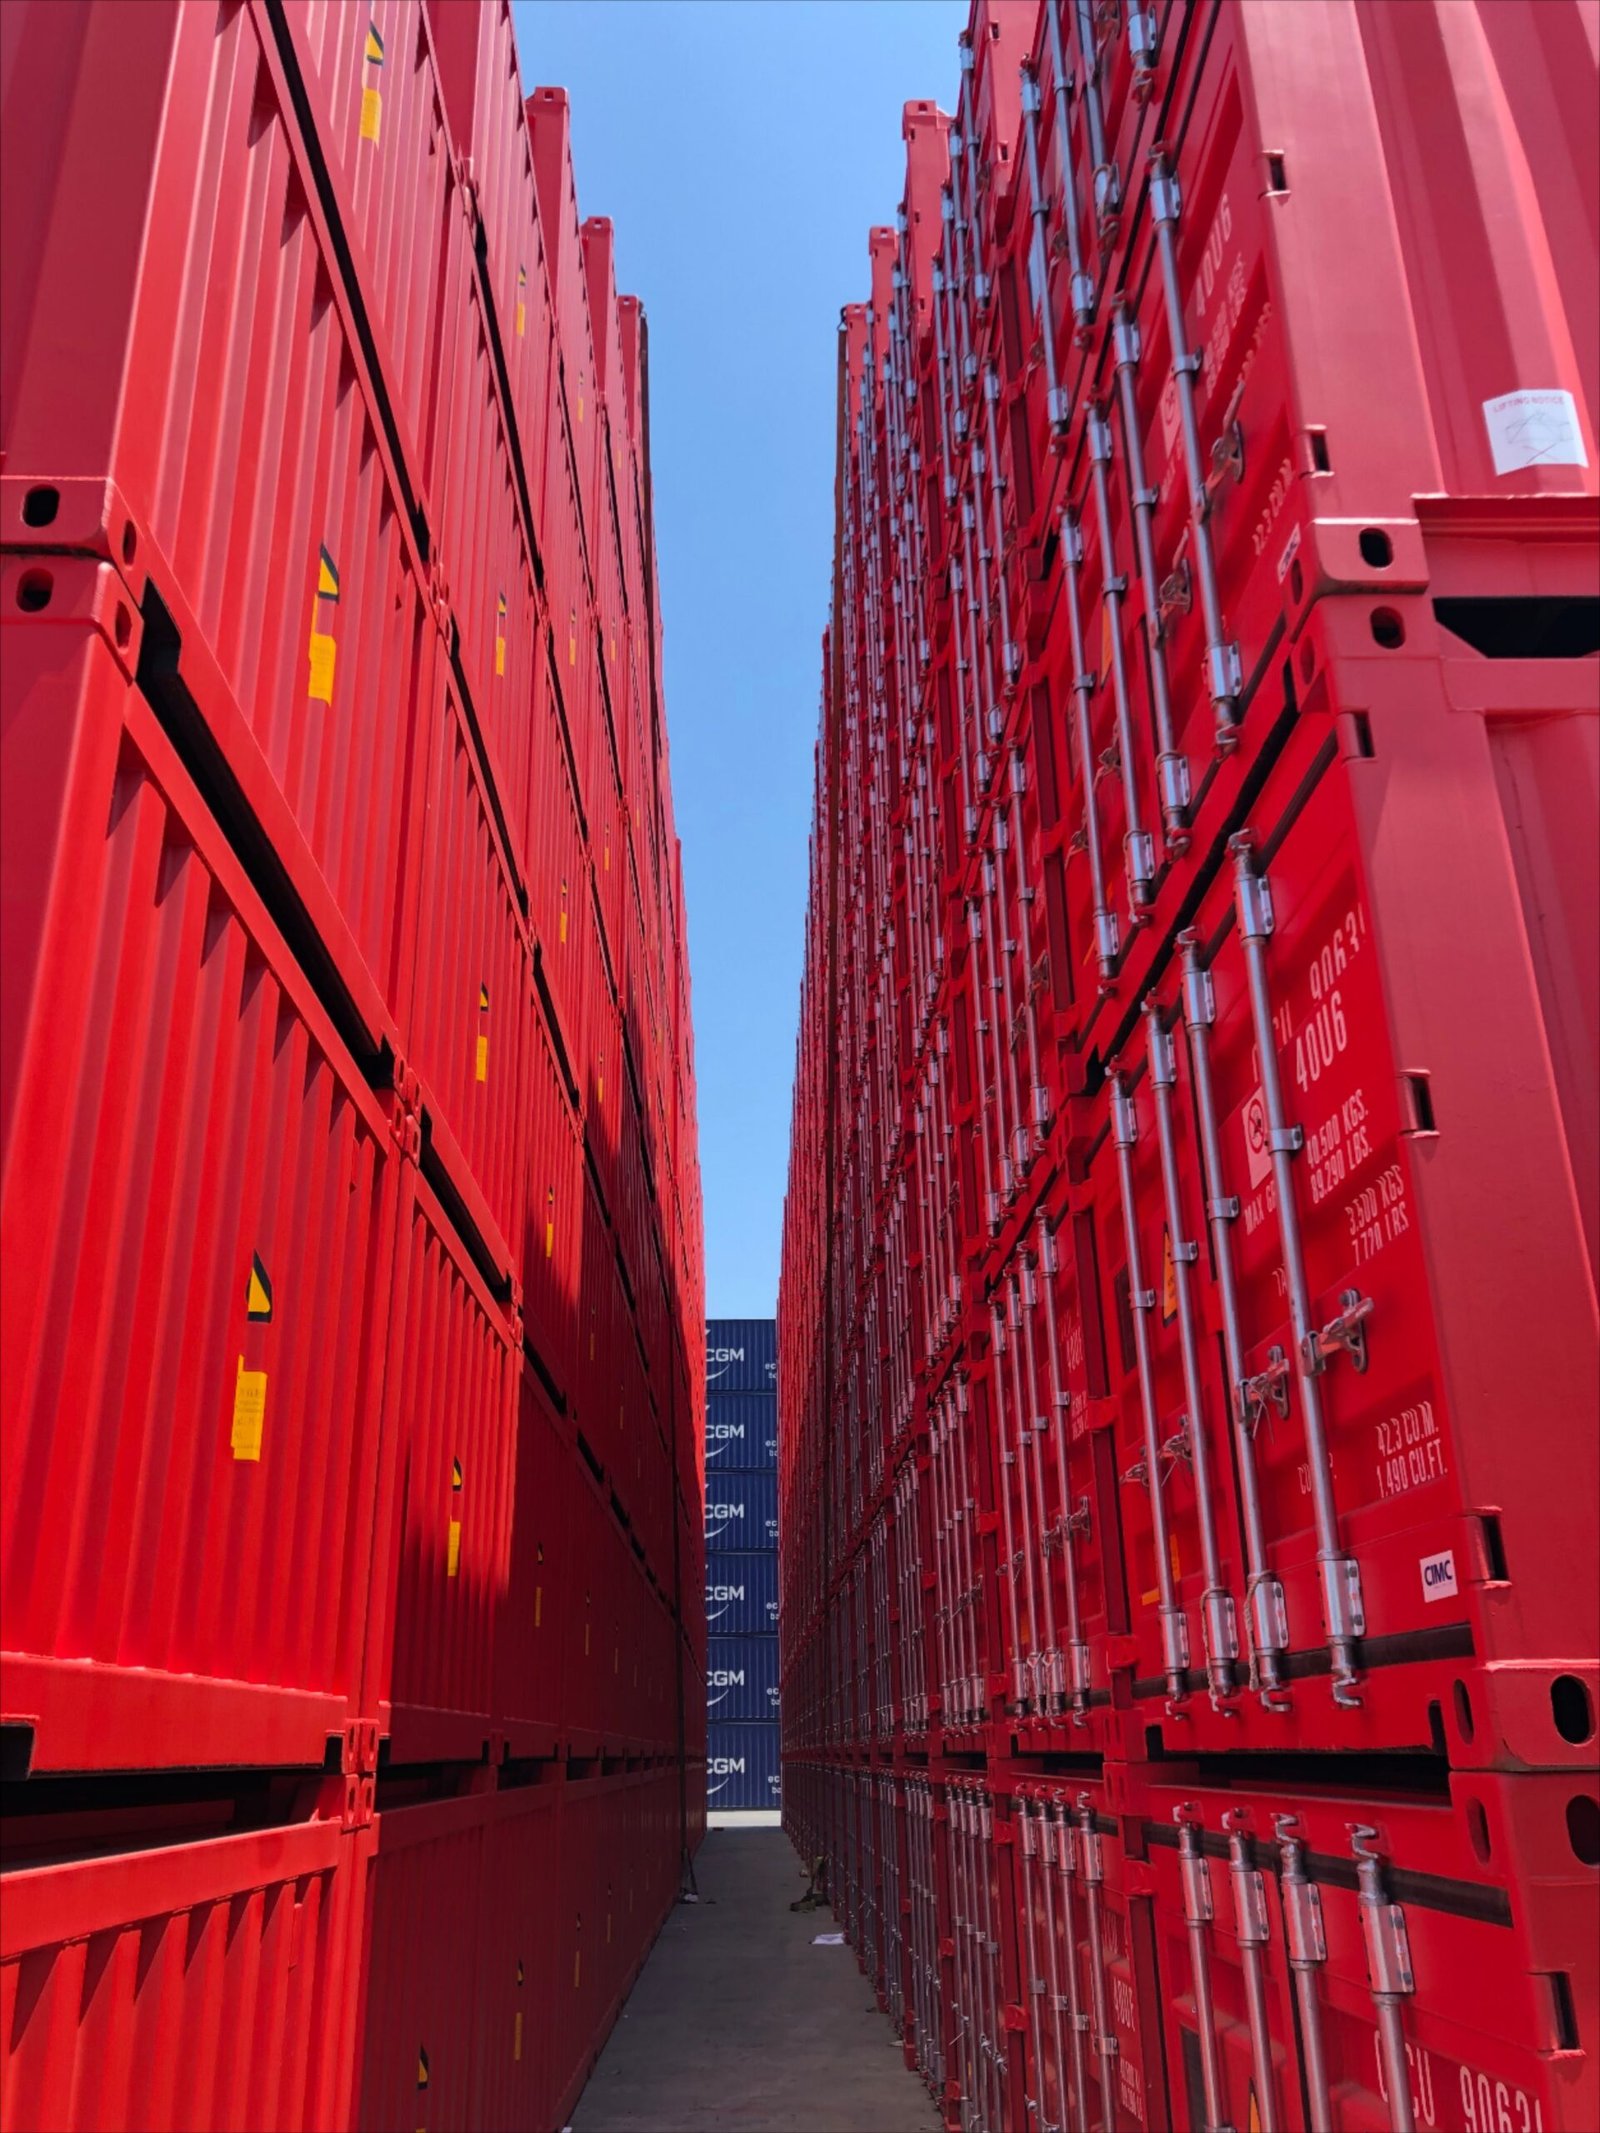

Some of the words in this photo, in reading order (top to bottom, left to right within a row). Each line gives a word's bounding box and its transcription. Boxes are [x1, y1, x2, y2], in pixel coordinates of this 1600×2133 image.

[1342, 1088, 1369, 1135] KGS.
[1376, 1455, 1408, 1498] 1.490
[1424, 1560, 1453, 1587] CIMC
